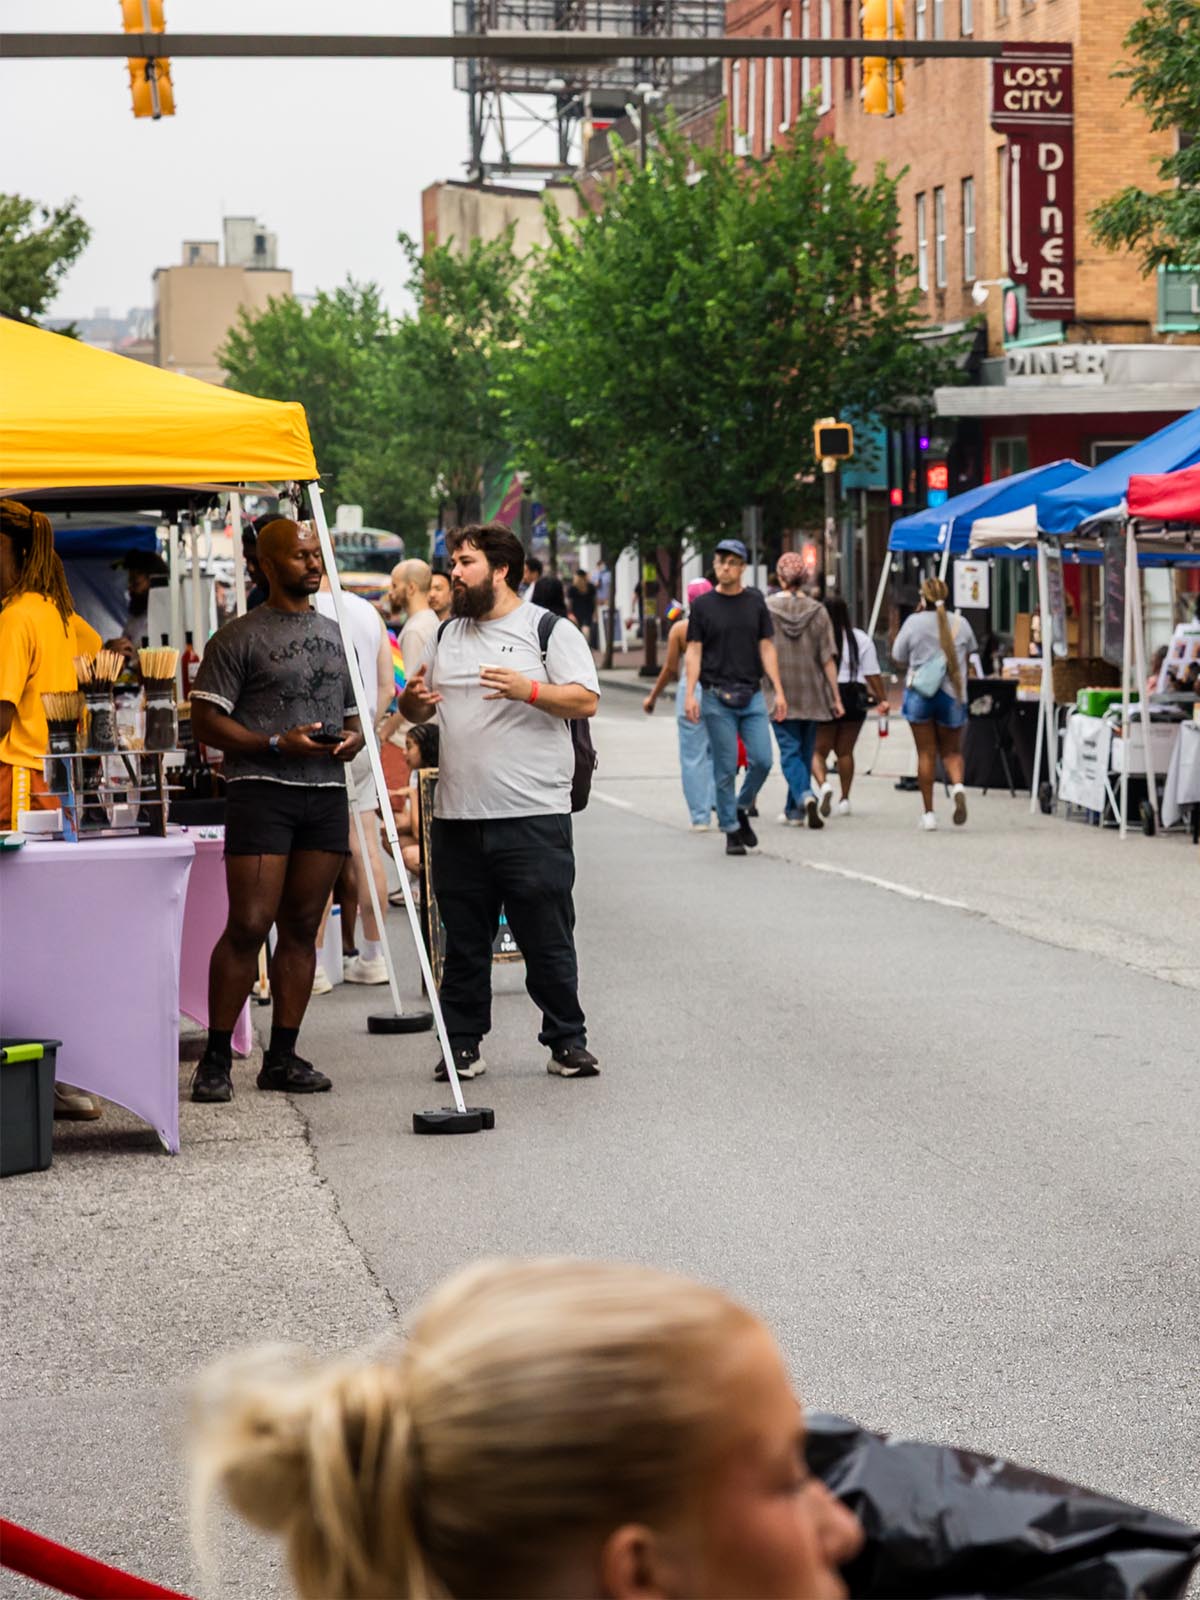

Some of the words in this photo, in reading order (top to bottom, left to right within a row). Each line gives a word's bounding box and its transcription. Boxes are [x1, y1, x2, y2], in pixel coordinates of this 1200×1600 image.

[1003, 67, 1063, 86] LOST
[1003, 89, 1063, 110] CITY
[1007, 351, 1106, 375] DINER
